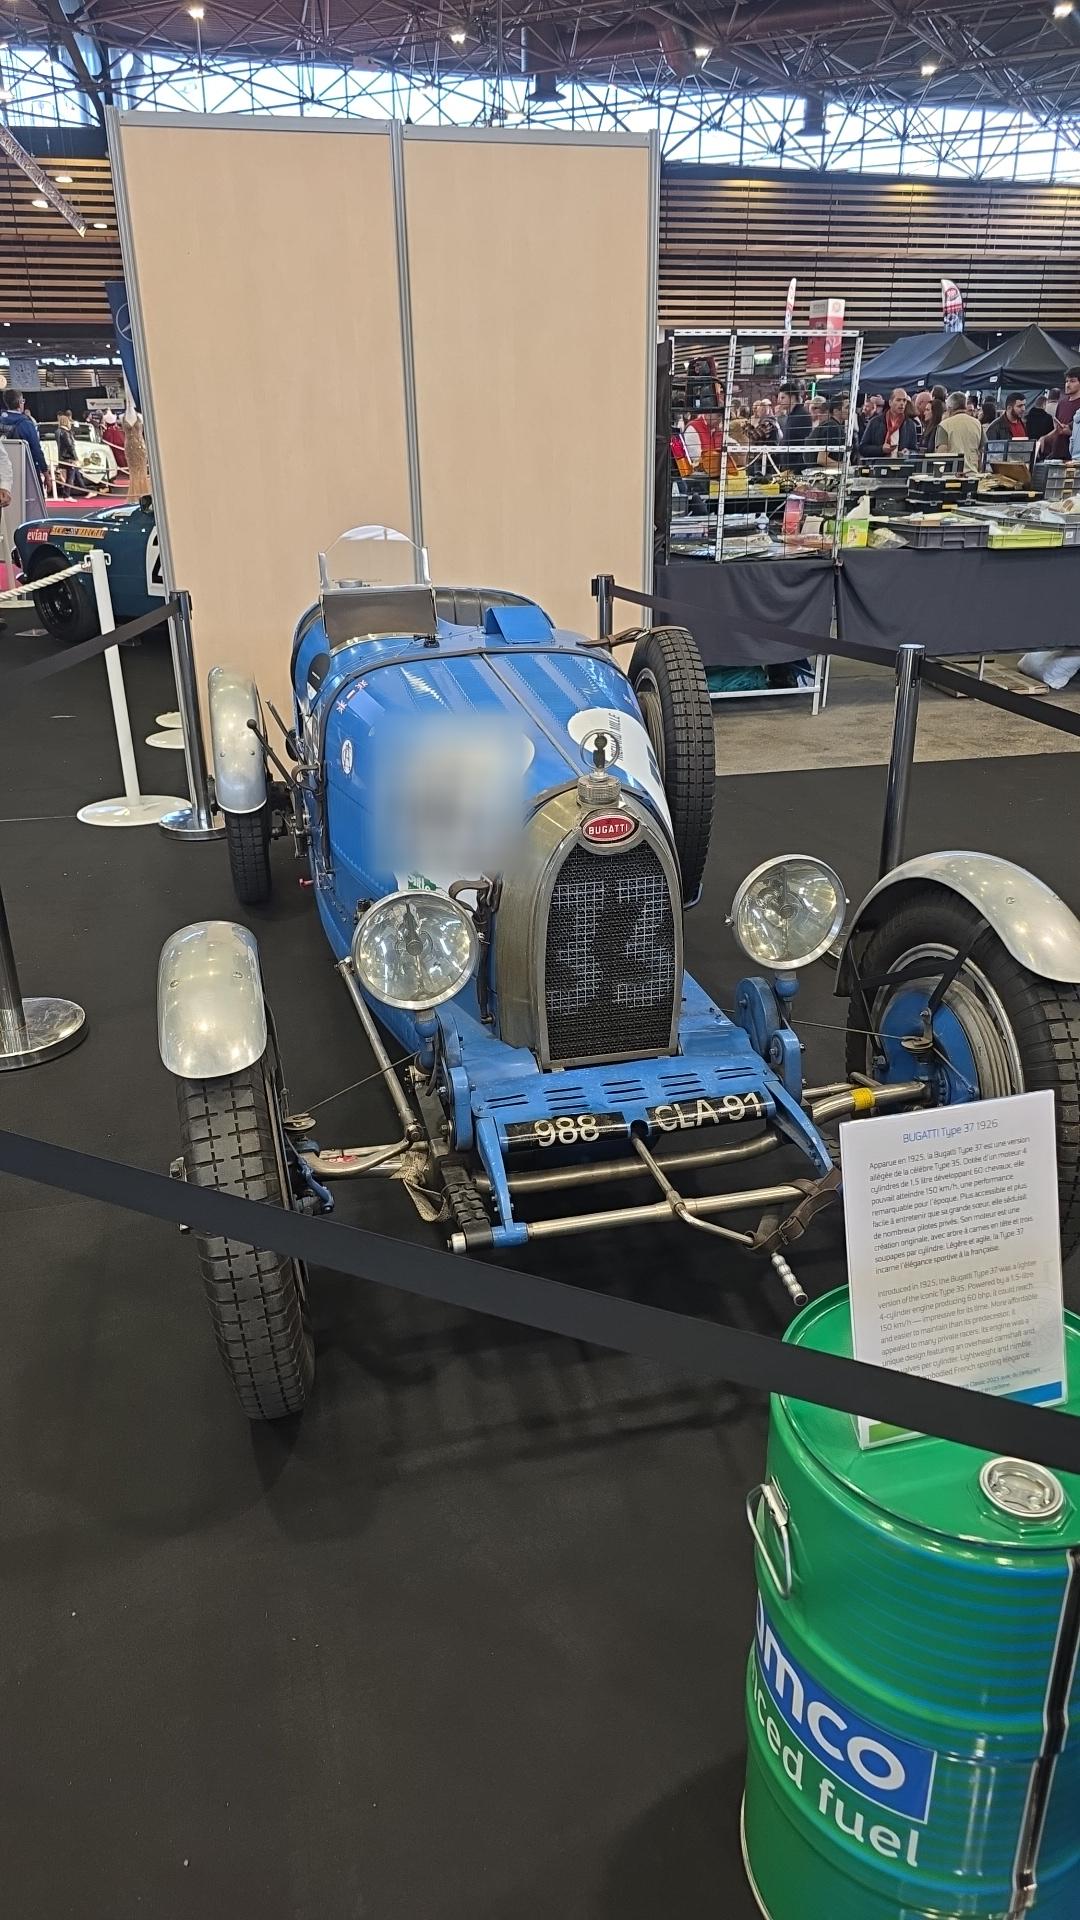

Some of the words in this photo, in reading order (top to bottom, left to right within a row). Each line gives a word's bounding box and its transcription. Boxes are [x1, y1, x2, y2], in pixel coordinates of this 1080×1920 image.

[27, 530, 49, 542] evian
[588, 823, 628, 835] BUGATTI
[534, 1114, 600, 1147] 988
[654, 1099, 720, 1132] CLA
[722, 1092, 763, 1121] 91
[903, 1128, 938, 1142] BUGATTI
[941, 1126, 961, 1138] Type
[963, 1122, 974, 1132] 37
[976, 1118, 998, 1130] 1926
[869, 1159, 896, 1170] Apparue
[958, 1146, 972, 1155] Type
[973, 1143, 981, 1151] 37
[1007, 1137, 1030, 1145] version
[869, 1171, 892, 1181] allégée
[910, 1165, 933, 1174] célèbre
[934, 1162, 949, 1171] Type
[998, 1150, 1020, 1158] moteur
[870, 1183, 899, 1193] cylindres
[933, 1168, 973, 1181] développant
[871, 1194, 894, 1206] pouvait
[896, 1190, 924, 1200] atteindre
[926, 1186, 937, 1194] 150
[973, 1174, 1013, 1188] performance
[871, 1203, 913, 1216] remarquable
[913, 1201, 928, 1210] pour
[974, 1186, 1006, 1197] accessible
[1014, 1183, 1027, 1192] plus
[872, 1219, 889, 1227] facile
[895, 1212, 926, 1223] entretenir
[927, 1210, 940, 1219] que
[948, 1204, 970, 1215] grande
[882, 1227, 915, 1237] nombreux
[917, 1222, 937, 1233] pilotes
[973, 1212, 995, 1220] moteur
[997, 1208, 1006, 1216] est
[873, 1241, 899, 1251] création
[946, 1229, 962, 1237] arbre
[968, 1224, 989, 1233] cames
[1019, 1215, 1032, 1223] trois
[874, 1252, 905, 1262] soupapes
[906, 1250, 917, 1258] par
[999, 1231, 1014, 1239] Type
[875, 1264, 899, 1273] incarne
[933, 1253, 957, 1264] sportive
[877, 1284, 911, 1296] Introduced
[950, 1271, 972, 1282] Bugatti
[973, 1270, 989, 1278] Type
[989, 1266, 997, 1274] 37
[878, 1299, 900, 1308] version
[920, 1290, 938, 1299] iconic
[939, 1288, 954, 1297] Type
[967, 1278, 995, 1290] Powered
[996, 1277, 1004, 1285] by
[911, 1304, 934, 1313] engine
[934, 1297, 966, 1310] producing
[880, 1323, 892, 1331] 150
[880, 1335, 892, 1343] and
[893, 1332, 911, 1340] easier
[920, 1324, 947, 1334] maintain
[881, 1343, 909, 1356] appealed
[918, 1338, 936, 1347] many
[937, 1333, 958, 1344] private
[904, 1352, 925, 1361] design
[926, 1346, 954, 1356] featuring
[1023, 1327, 1034, 1335] and
[921, 1362, 932, 1370] per
[953, 1363, 975, 1373] French
[817, 1780, 920, 1867] fuel
